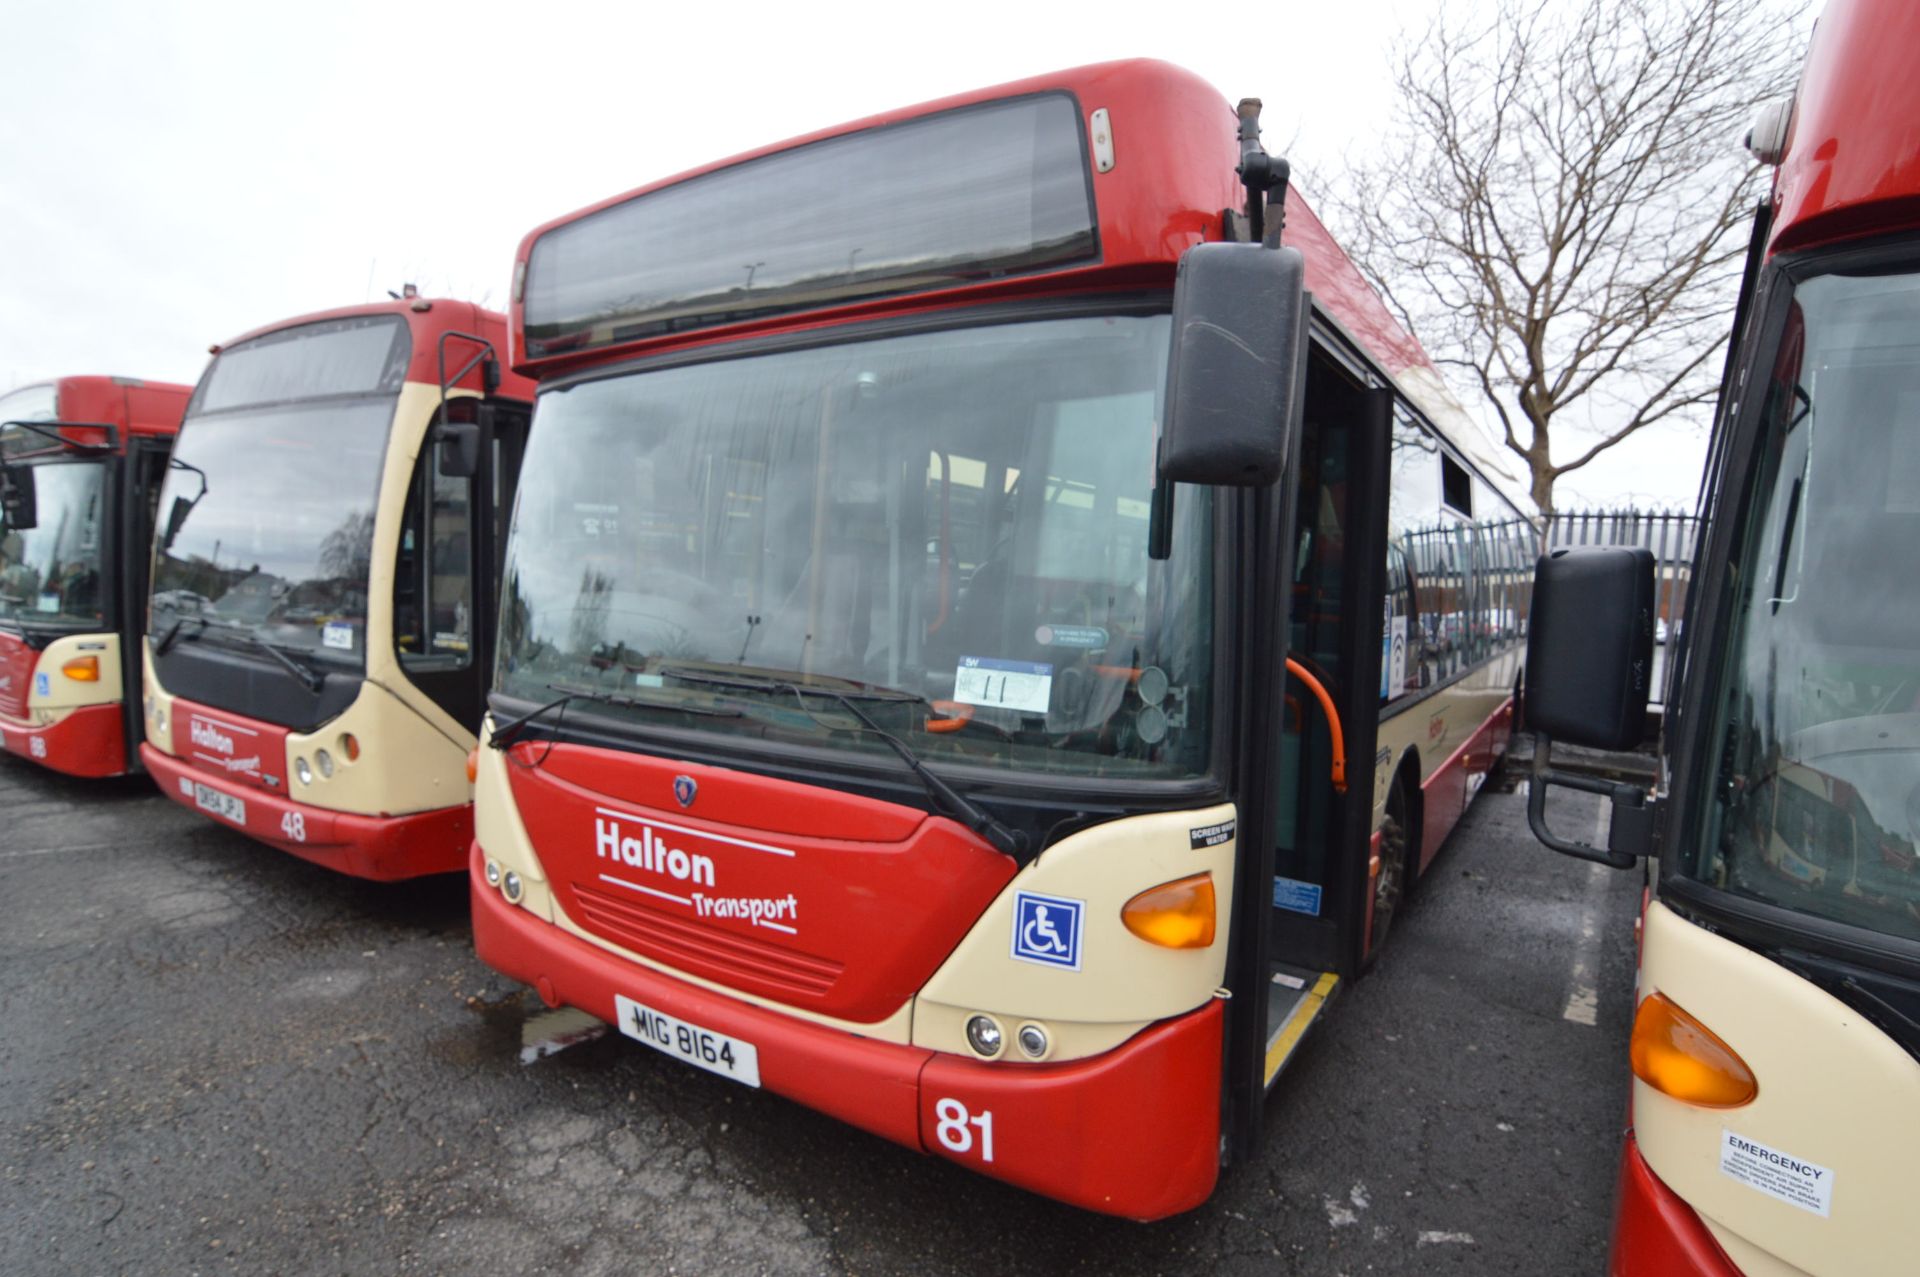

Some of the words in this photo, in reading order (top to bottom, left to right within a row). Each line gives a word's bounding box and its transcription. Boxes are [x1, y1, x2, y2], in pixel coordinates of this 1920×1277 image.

[983, 675, 1006, 703] 11
[191, 719, 234, 755] Halton
[224, 754, 260, 772] Transport
[281, 811, 306, 842] 48
[1191, 825, 1220, 840] SCREEN
[1205, 832, 1228, 846] WATER
[596, 818, 715, 887] Halton
[691, 883, 797, 925] Transport
[632, 1006, 670, 1046] MIG
[676, 1025, 735, 1071] 8164
[936, 1097, 993, 1162] 81
[1728, 1135, 1823, 1180] EMERGENCY
[1731, 1157, 1775, 1178] INDEPENDENT
[1776, 1176, 1788, 1184] AIR
[1789, 1180, 1814, 1194] SUPPLY
[1759, 1163, 1803, 1184] CONNECTING
[1804, 1180, 1814, 1188] AN
[1778, 1182, 1796, 1194] PARK
[1769, 1185, 1787, 1197] PARK
[1788, 1193, 1821, 1210] POSITION
